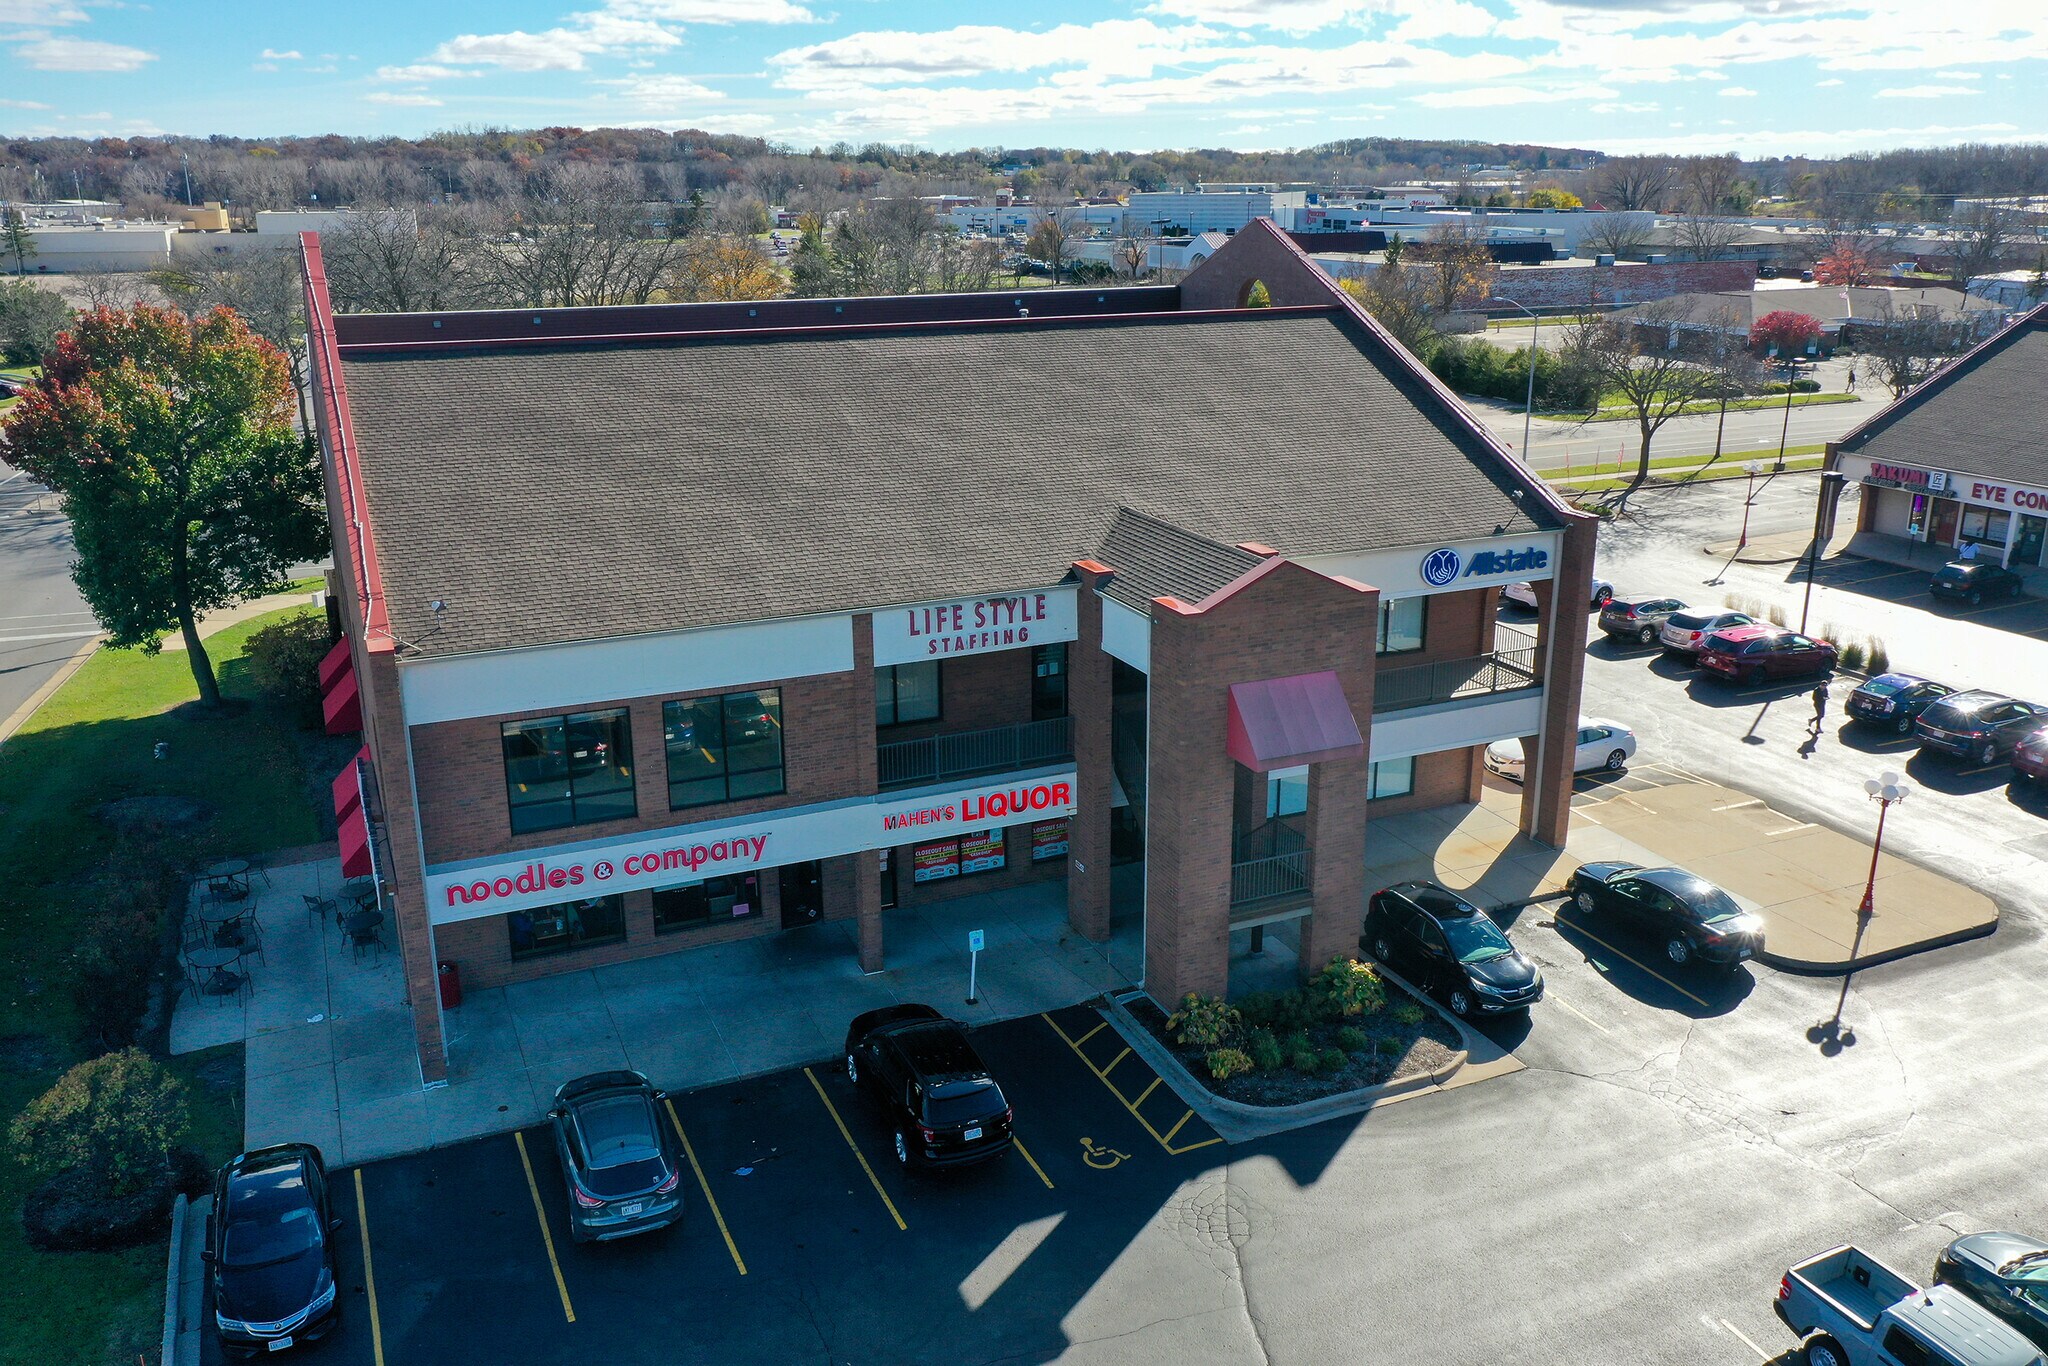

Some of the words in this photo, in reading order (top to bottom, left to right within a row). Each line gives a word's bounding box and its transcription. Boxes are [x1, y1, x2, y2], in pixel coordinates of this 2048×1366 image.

[1870, 462, 1929, 486] TAKUMI
[1971, 483, 2007, 503] EYE
[2013, 490, 2048, 511] CON
[1461, 546, 1548, 578] Allstate
[908, 604, 963, 636] LIFE
[974, 594, 1046, 629] STYLE
[928, 626, 1029, 655] STAFFING
[883, 804, 956, 831] MAHEN'S
[961, 782, 1071, 822] LIQUOR
[1033, 824, 1056, 833] LOSEOUT
[915, 846, 942, 857] CLOSEOUT
[961, 839, 987, 849] CLOSEOUT
[446, 863, 585, 907] noodles
[595, 862, 612, 880] &
[623, 834, 767, 876] company
